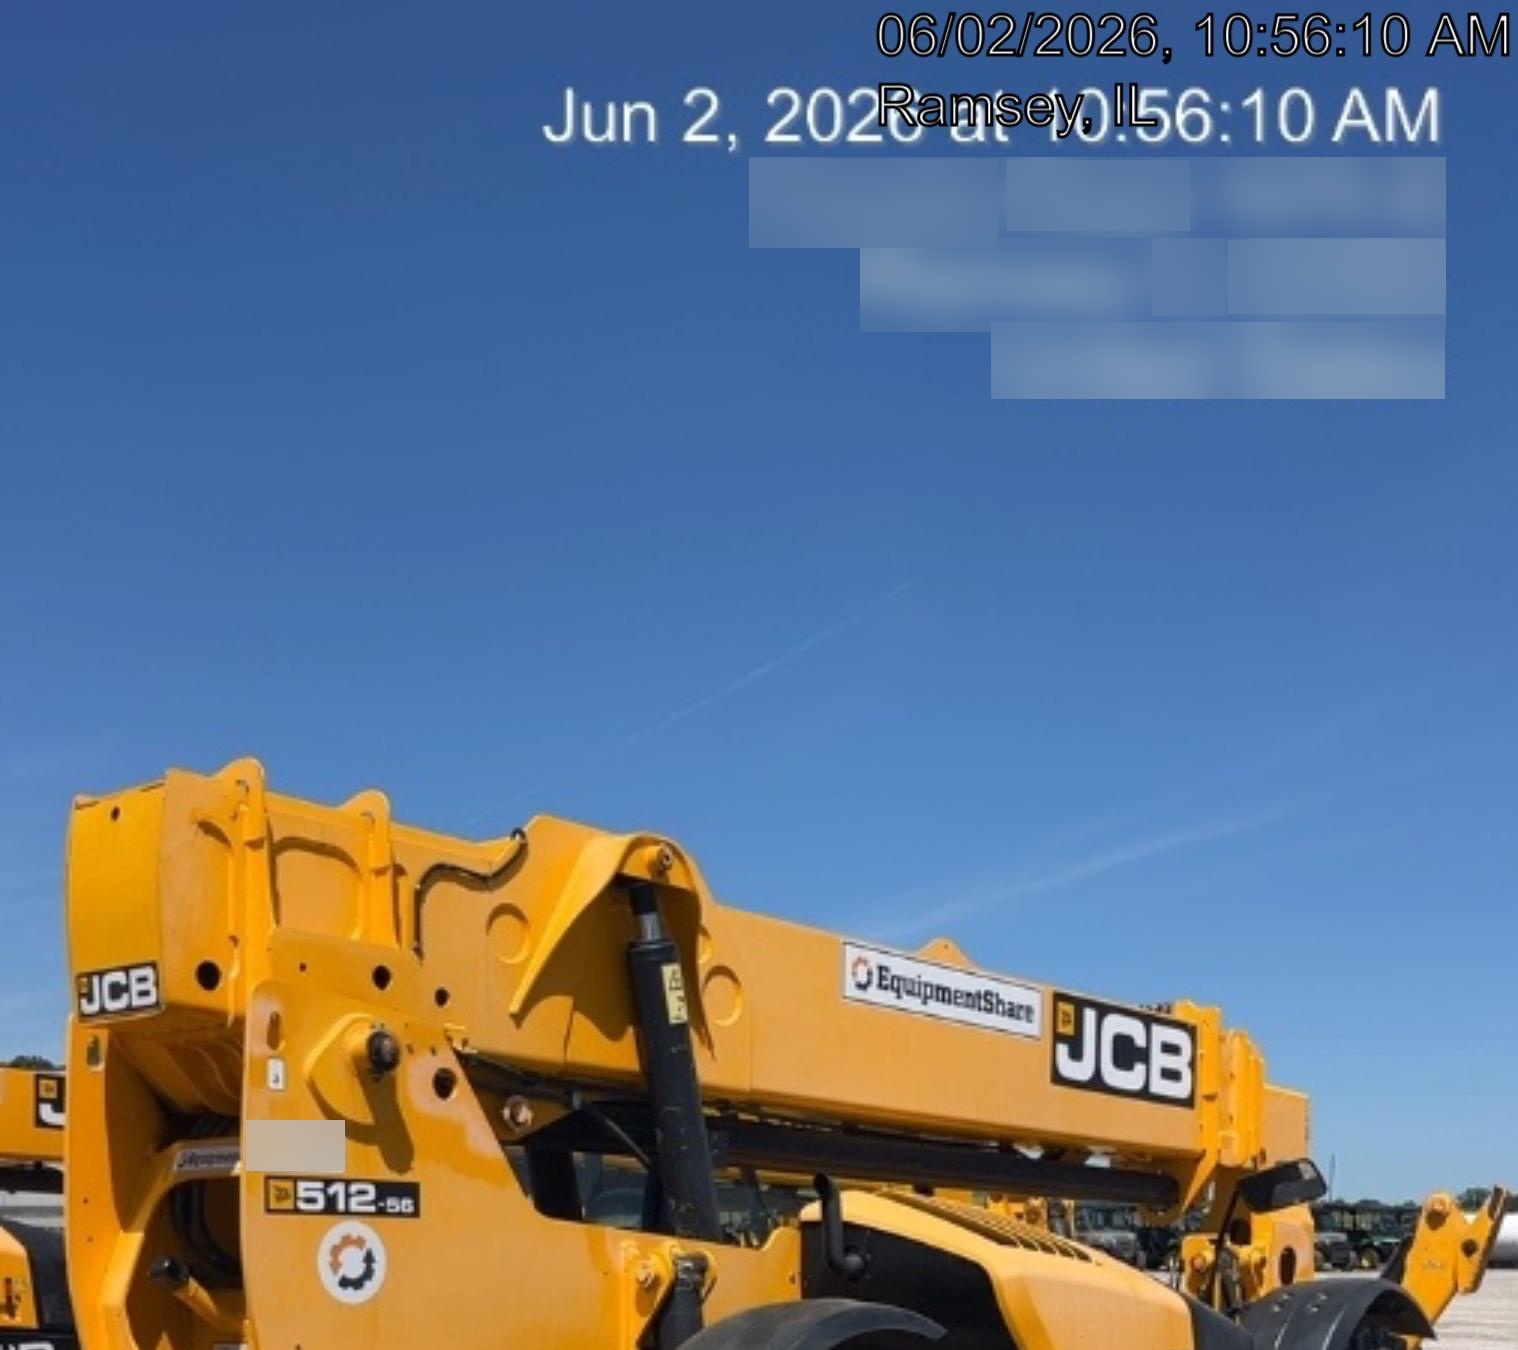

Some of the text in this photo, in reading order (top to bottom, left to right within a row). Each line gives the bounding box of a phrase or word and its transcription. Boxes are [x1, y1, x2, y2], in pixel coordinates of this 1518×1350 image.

[80, 966, 157, 1015] JCB
[876, 965, 1034, 1023] EquipmentShare
[1056, 1007, 1192, 1099] JCB
